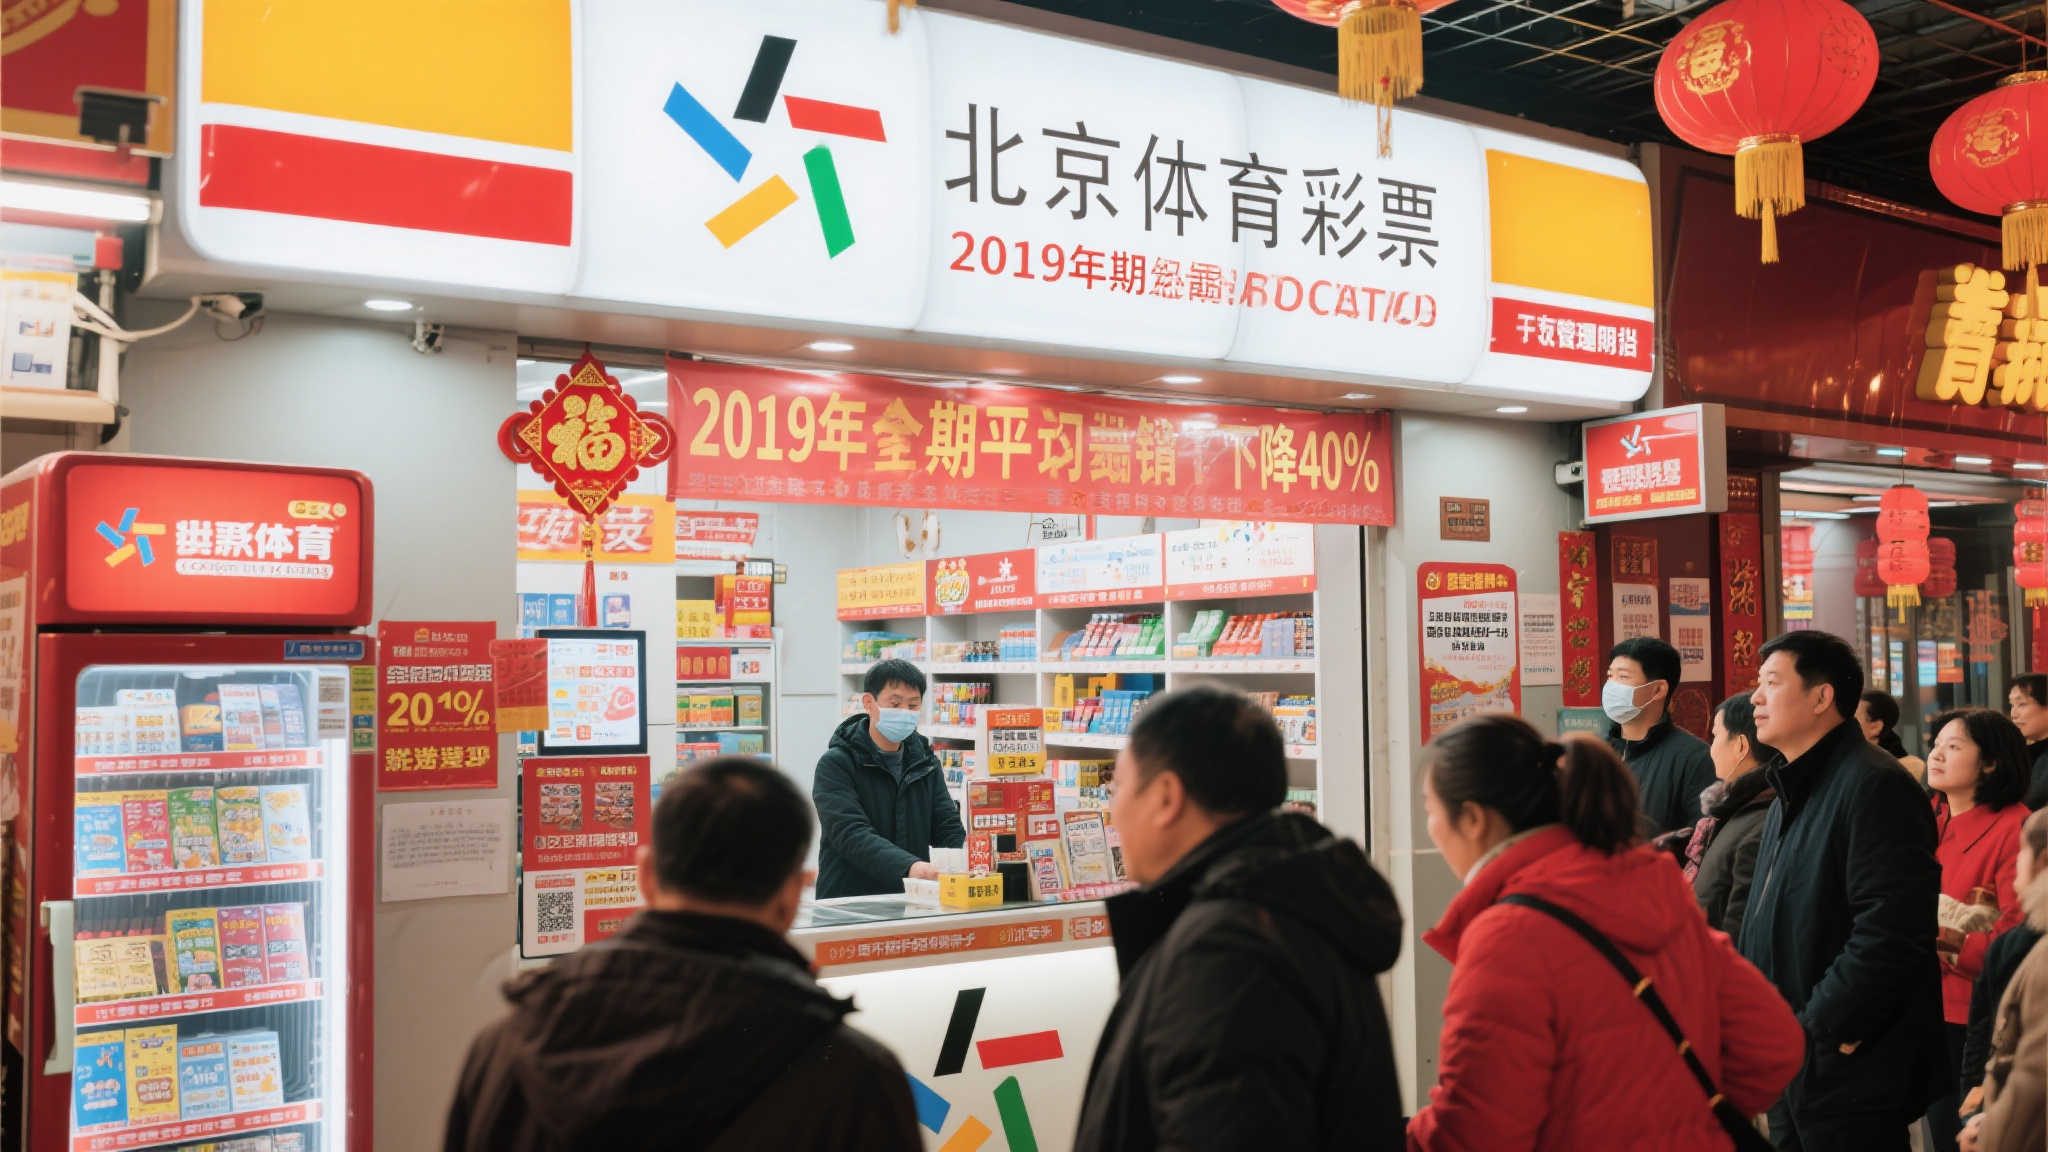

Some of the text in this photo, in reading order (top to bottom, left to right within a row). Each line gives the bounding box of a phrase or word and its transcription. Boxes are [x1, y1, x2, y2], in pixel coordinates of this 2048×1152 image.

[944, 103, 1439, 268] 北京体育彩票
[546, 393, 627, 472] 福
